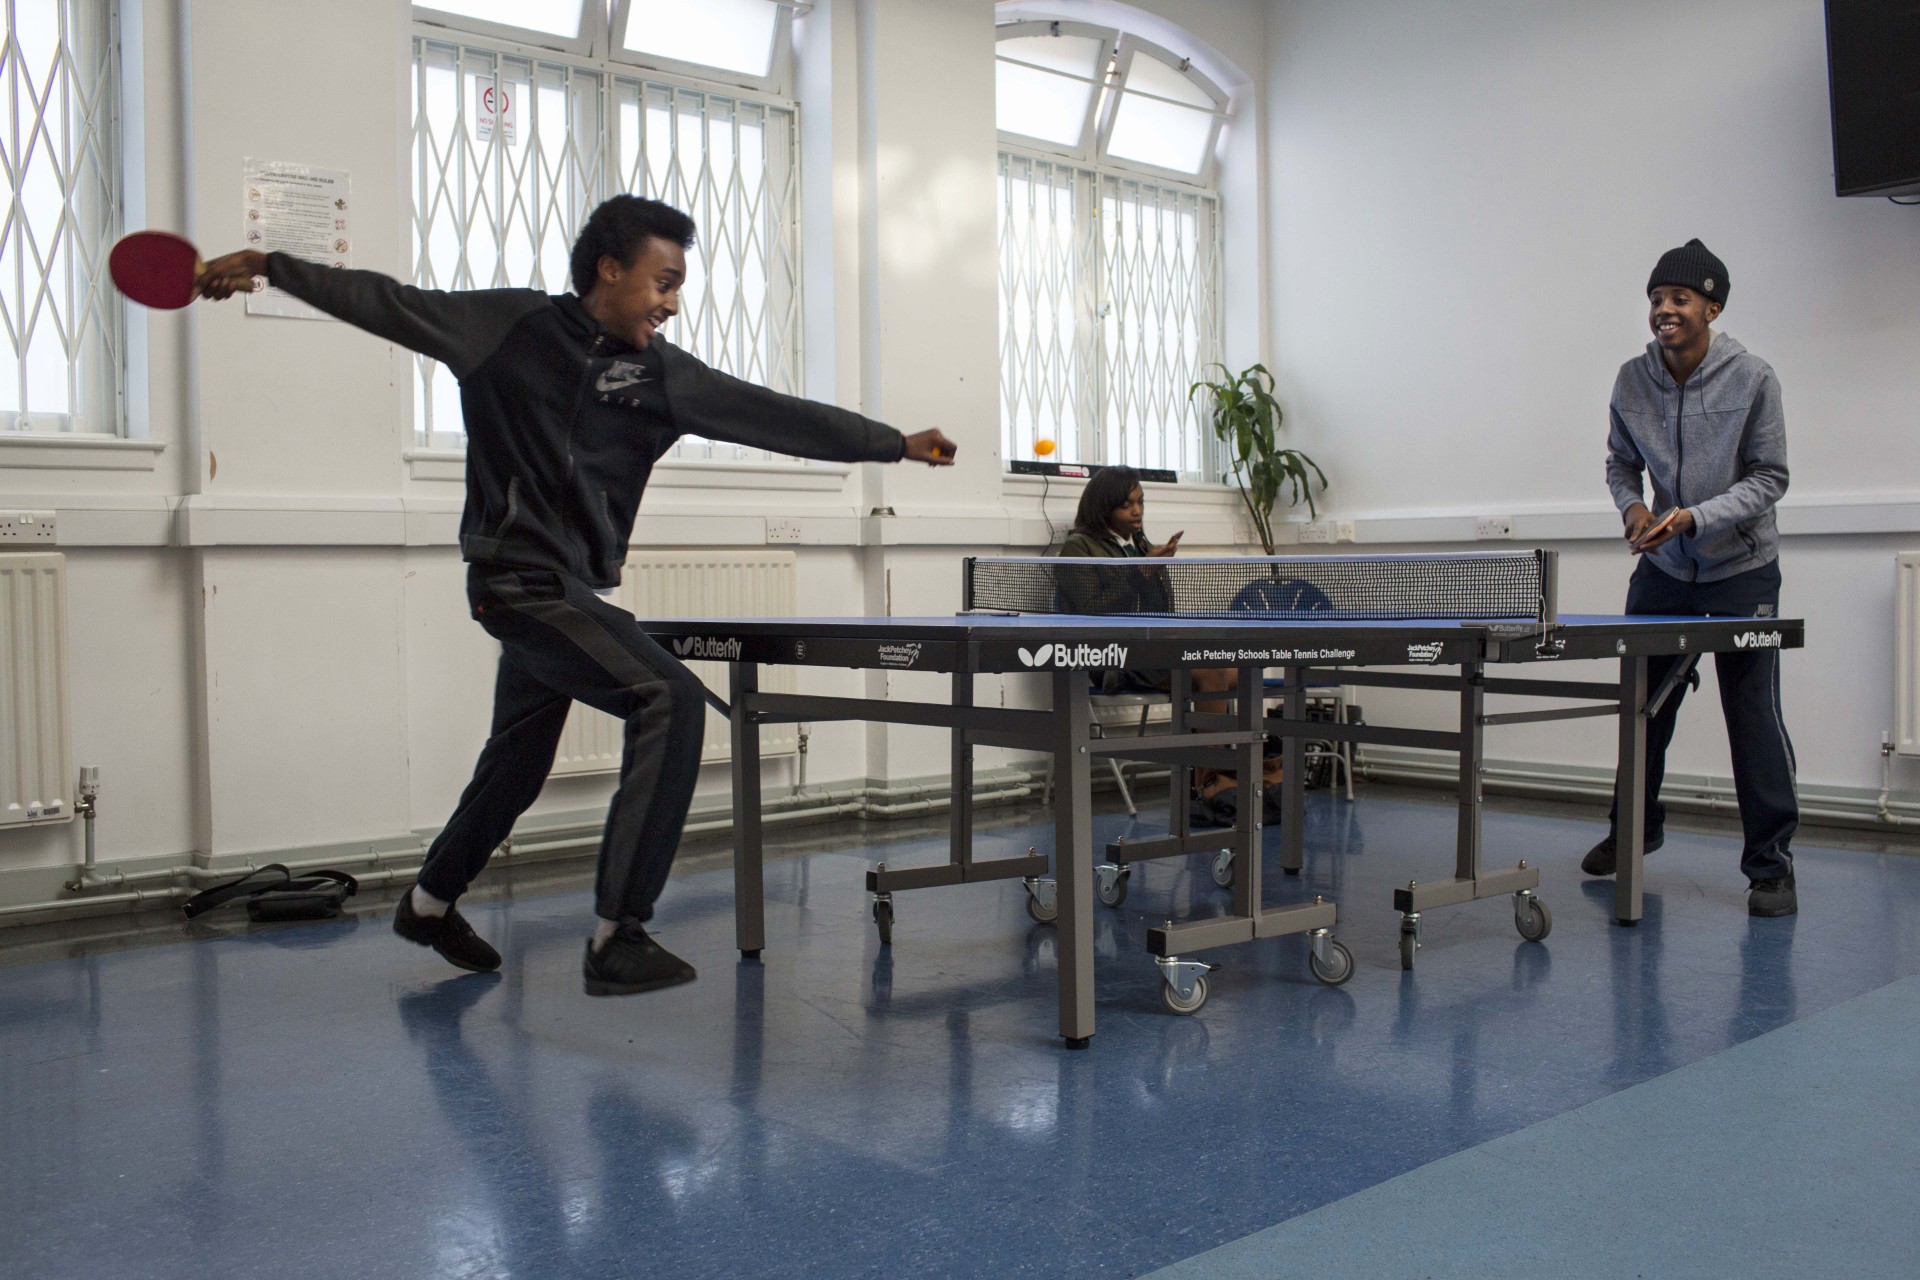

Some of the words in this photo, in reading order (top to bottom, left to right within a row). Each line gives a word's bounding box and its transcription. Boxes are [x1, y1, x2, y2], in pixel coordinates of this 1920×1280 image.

[1757, 603, 1774, 615] NIKE
[1749, 631, 1782, 648] Butterfly
[694, 636, 742, 661] Butterfly
[1054, 643, 1128, 669] Butterfly
[1181, 650, 1201, 661] Jack
[1203, 650, 1236, 662] Petchey
[1238, 649, 1270, 660] Schools
[1271, 649, 1293, 659] Table
[1293, 649, 1318, 659] Tennis
[1319, 649, 1356, 660] Challenge
[880, 653, 909, 662] Foundation
